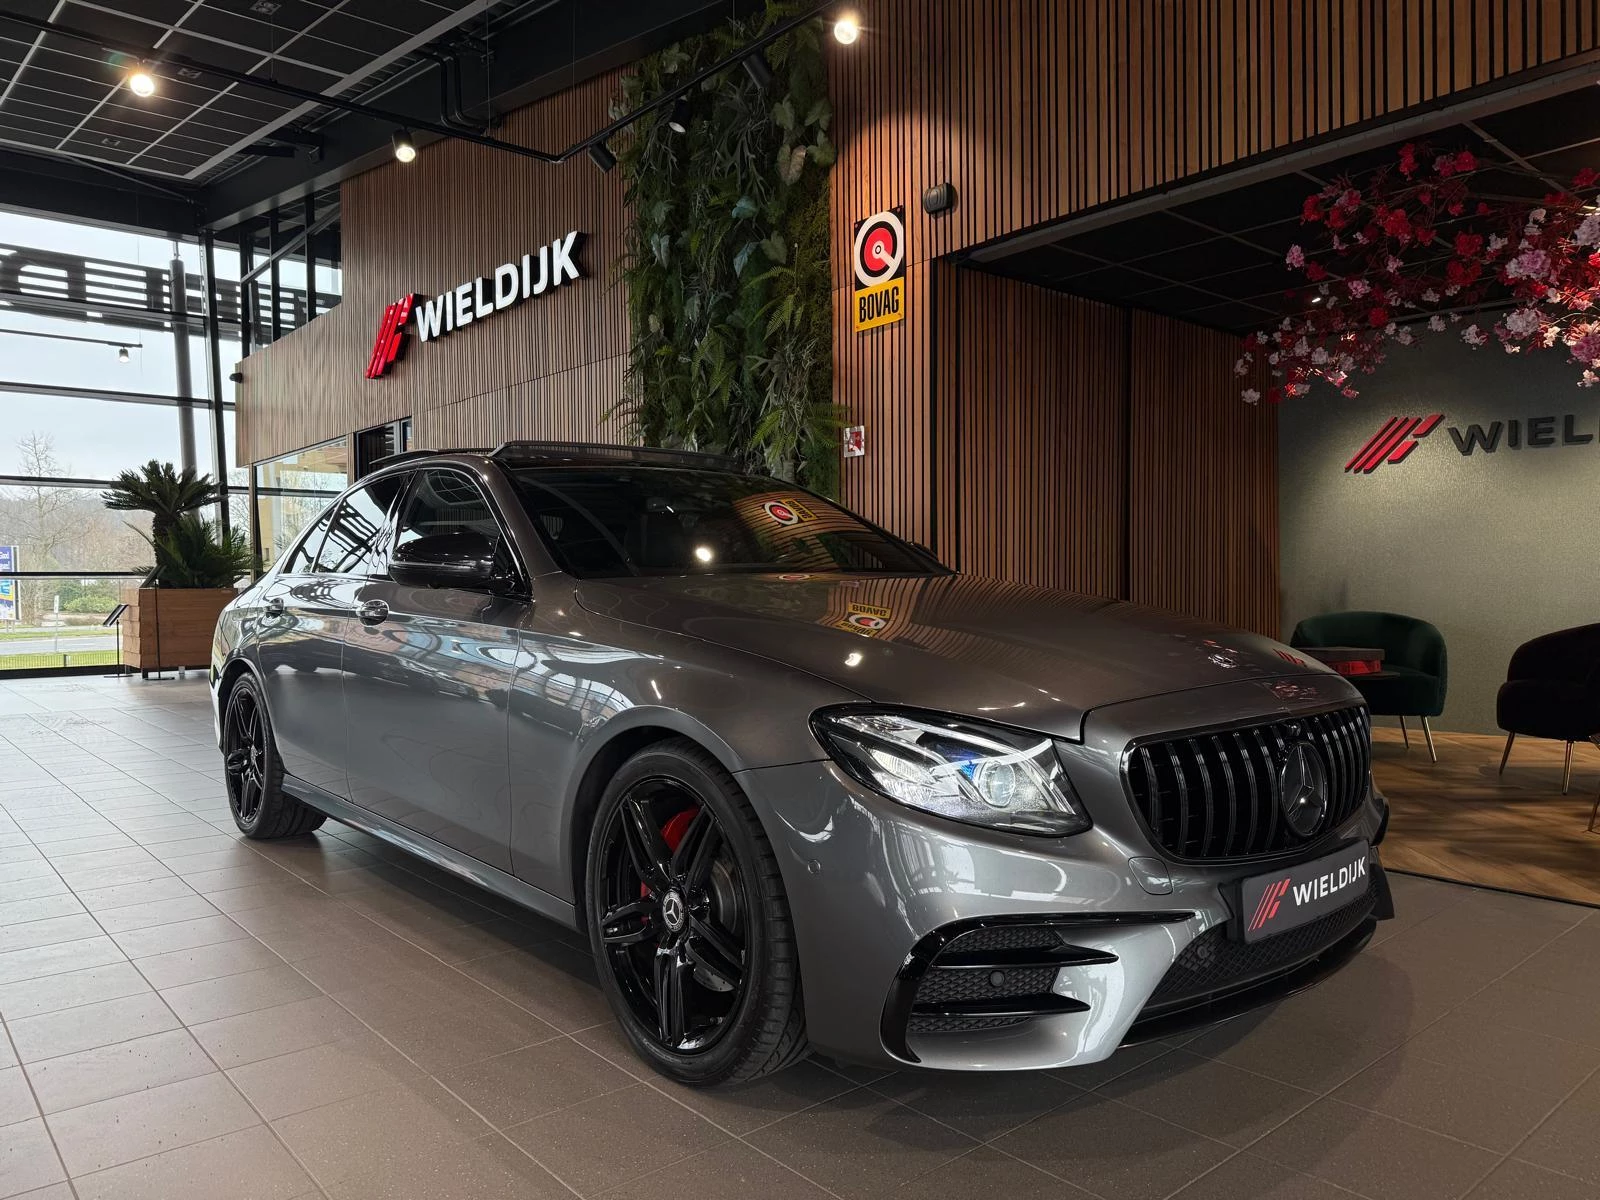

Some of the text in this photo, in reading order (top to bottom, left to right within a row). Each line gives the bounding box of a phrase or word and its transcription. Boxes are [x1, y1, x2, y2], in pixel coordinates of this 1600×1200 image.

[415, 230, 580, 343] WIELDIJK
[859, 286, 900, 323] BOVAG
[1448, 414, 1600, 456] WIEL
[1292, 856, 1366, 906] WIELDIJK
